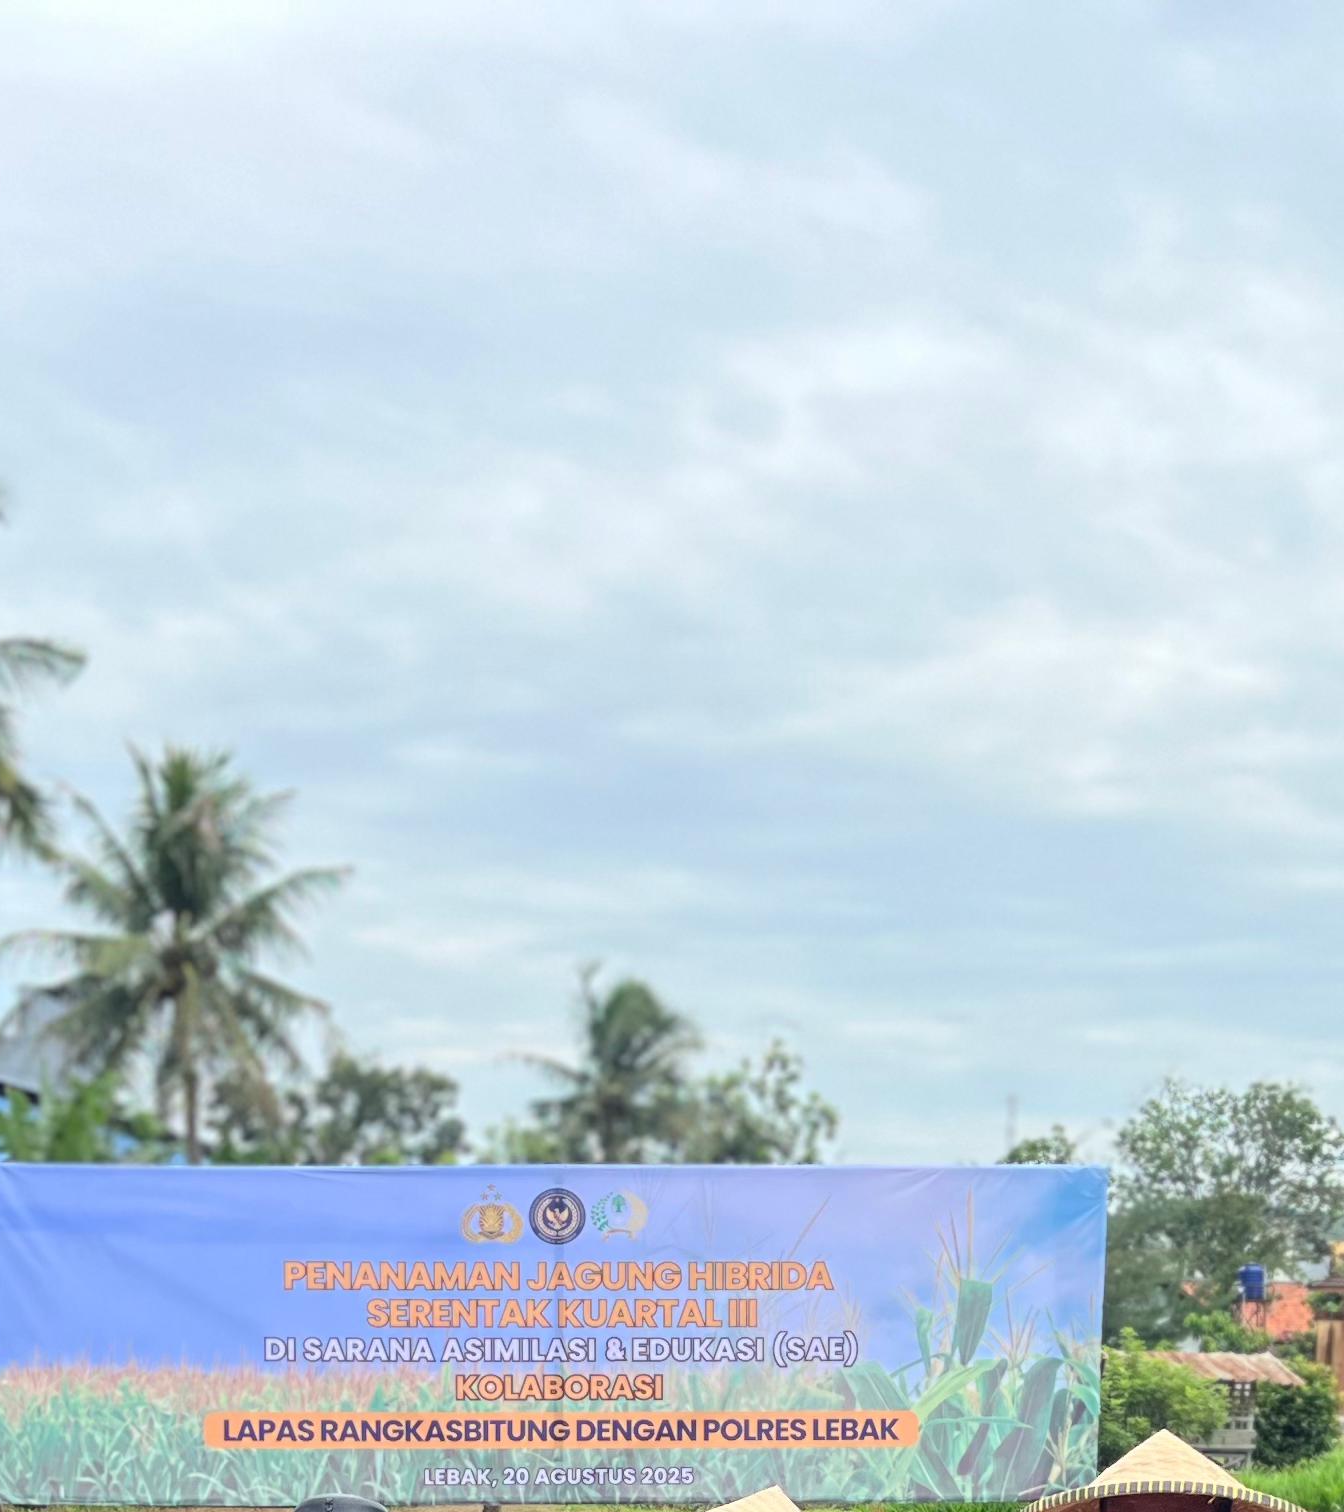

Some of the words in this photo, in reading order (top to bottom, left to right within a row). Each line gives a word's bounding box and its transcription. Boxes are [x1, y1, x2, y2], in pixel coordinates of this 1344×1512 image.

[283, 1261, 520, 1290] PENANAMAN
[527, 1261, 682, 1291] JAGUNG
[688, 1261, 834, 1291] HIBRIDA
[367, 1299, 552, 1328] SERENTAK
[558, 1299, 722, 1328] KUARTAL
[728, 1299, 758, 1328] III
[264, 1337, 296, 1361] DI
[303, 1337, 436, 1362] SARANA
[441, 1337, 596, 1362] ASIMILASI
[605, 1336, 627, 1362] &
[632, 1337, 764, 1362] EDUKASI
[773, 1331, 859, 1367] (SAE)
[456, 1374, 664, 1401] KOLABORASI
[223, 1419, 314, 1442] LAPAS
[320, 1419, 570, 1442] RANGKASBITUNG
[576, 1419, 697, 1441] DENGAN
[703, 1418, 806, 1441] POLRES
[813, 1418, 899, 1440] LEBAK
[423, 1467, 498, 1488] LEBAK,
[502, 1467, 529, 1486] 20
[534, 1467, 636, 1486] AGUSTUS
[641, 1466, 695, 1485] 2025
